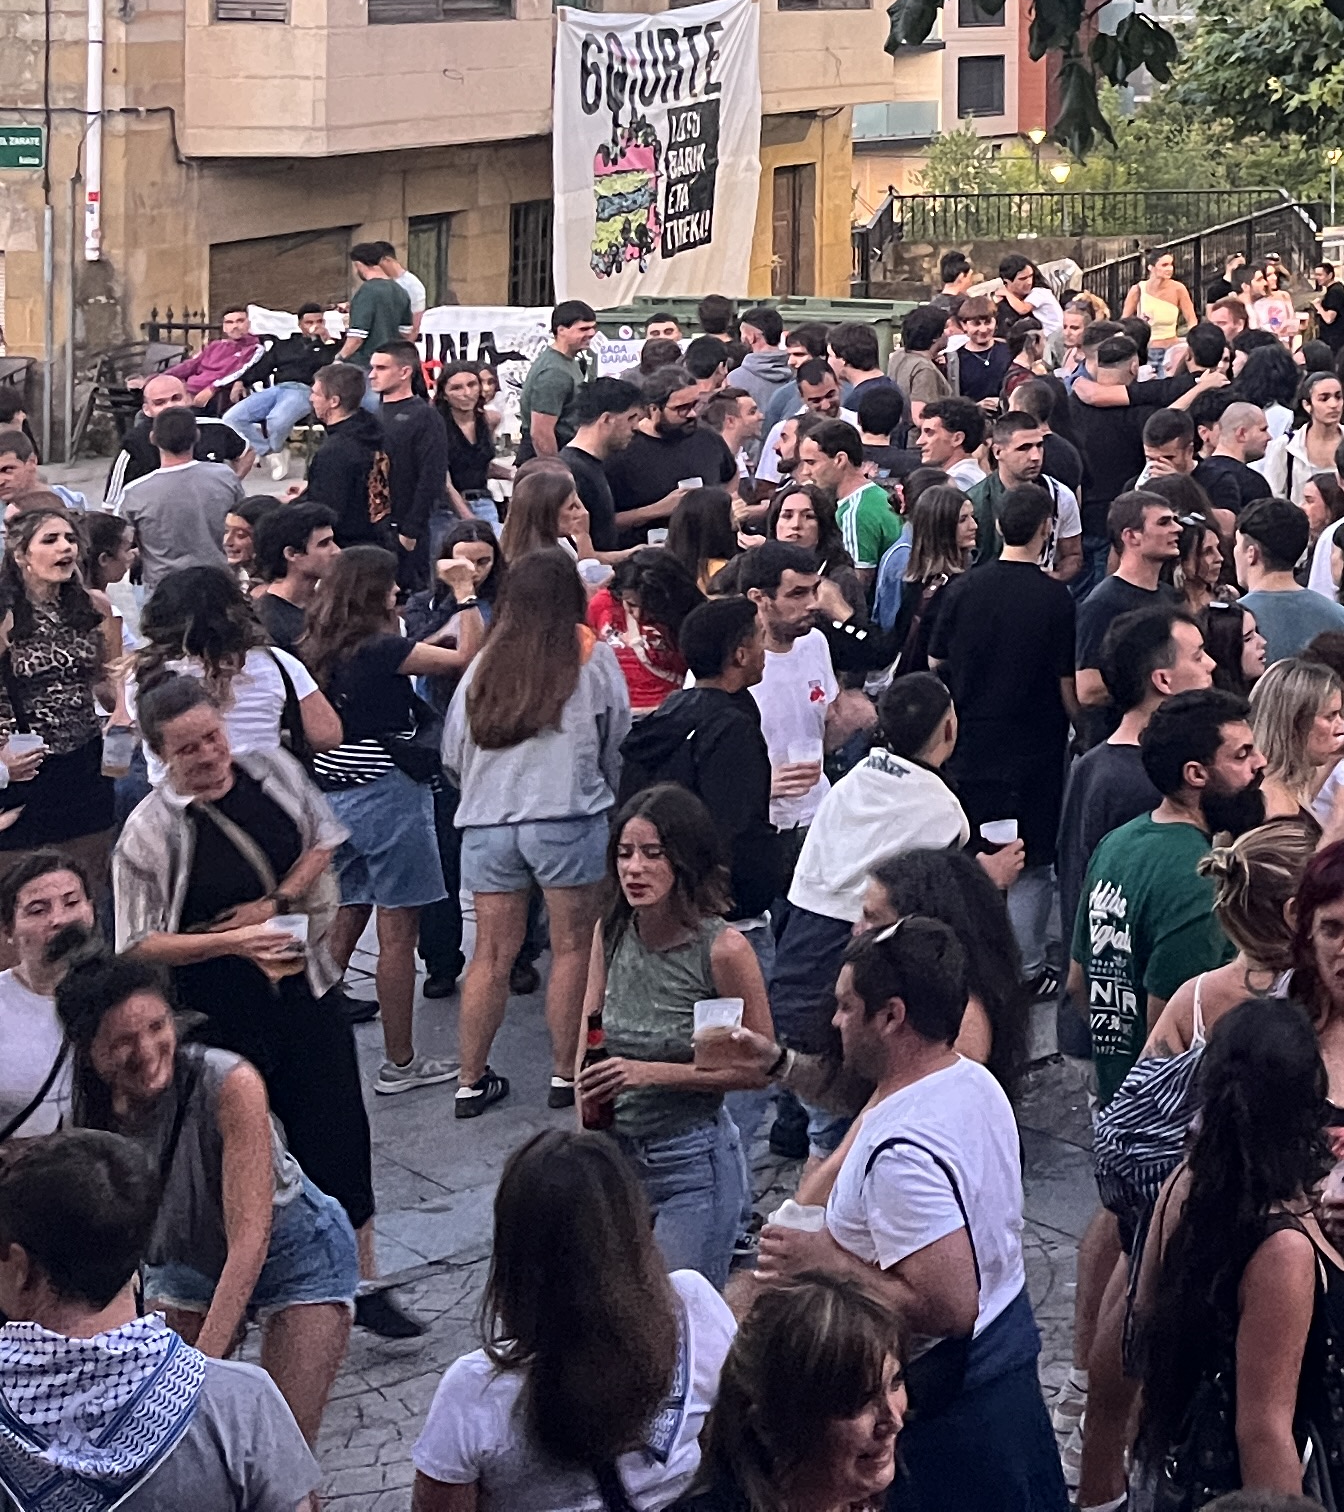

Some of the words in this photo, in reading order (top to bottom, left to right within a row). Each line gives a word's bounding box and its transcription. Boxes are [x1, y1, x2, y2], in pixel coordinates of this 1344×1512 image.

[634, 21, 724, 108] URTE
[9, 136, 41, 146] ZARATE
[667, 182, 690, 215] ETA
